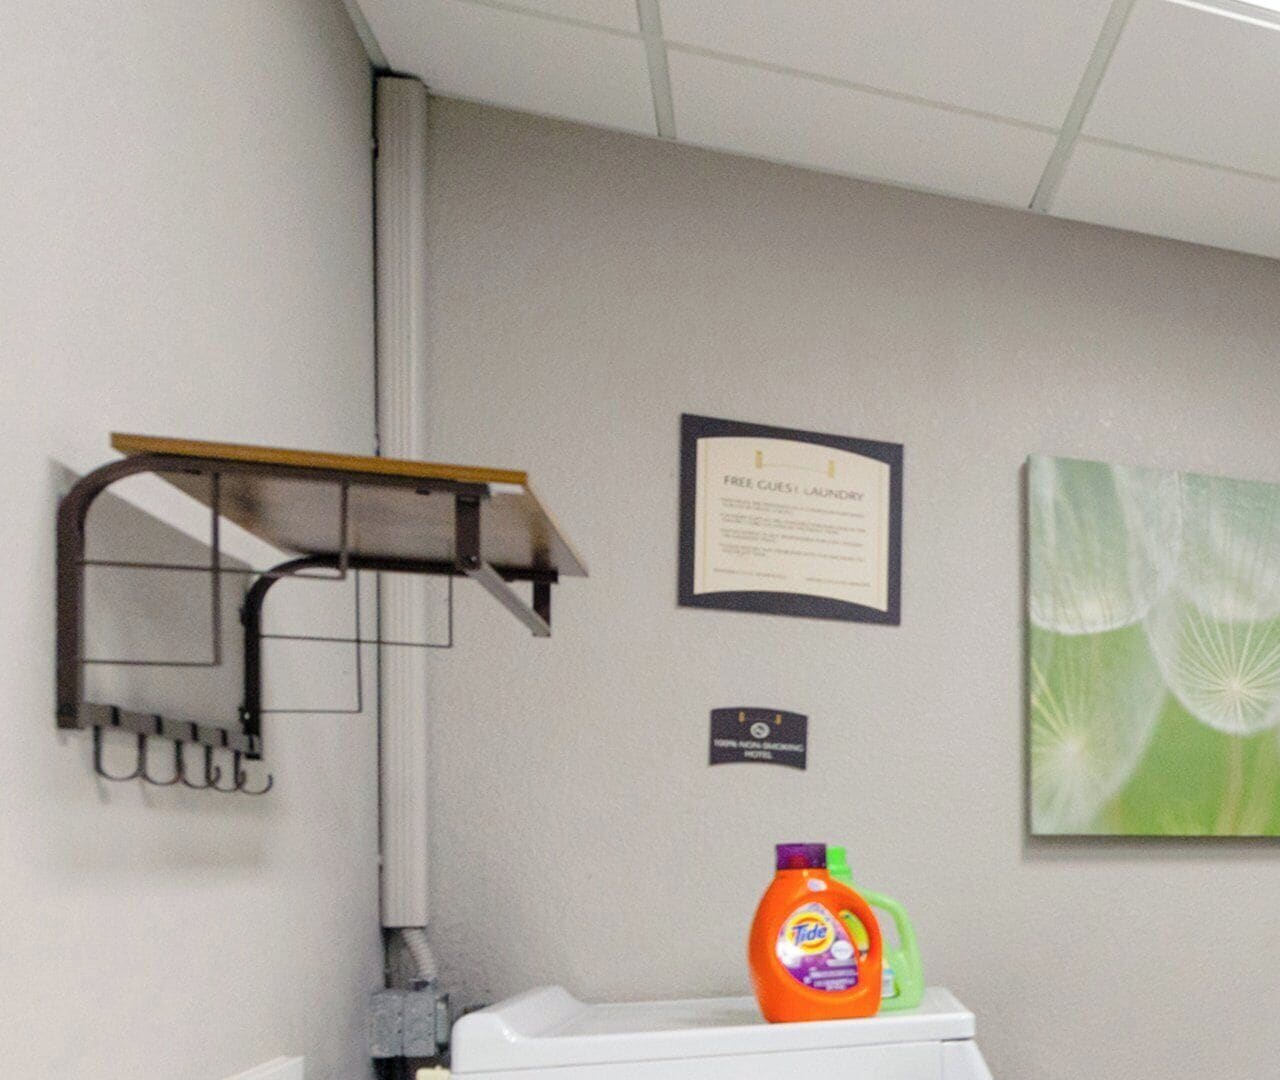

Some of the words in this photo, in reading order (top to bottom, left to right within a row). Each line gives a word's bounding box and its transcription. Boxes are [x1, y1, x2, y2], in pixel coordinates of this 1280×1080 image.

[723, 474, 753, 490] FREE
[756, 479, 799, 495] GUEST
[804, 485, 864, 502] LAUNDRY
[744, 749, 773, 759] HOTEL
[792, 923, 828, 946] Tide
